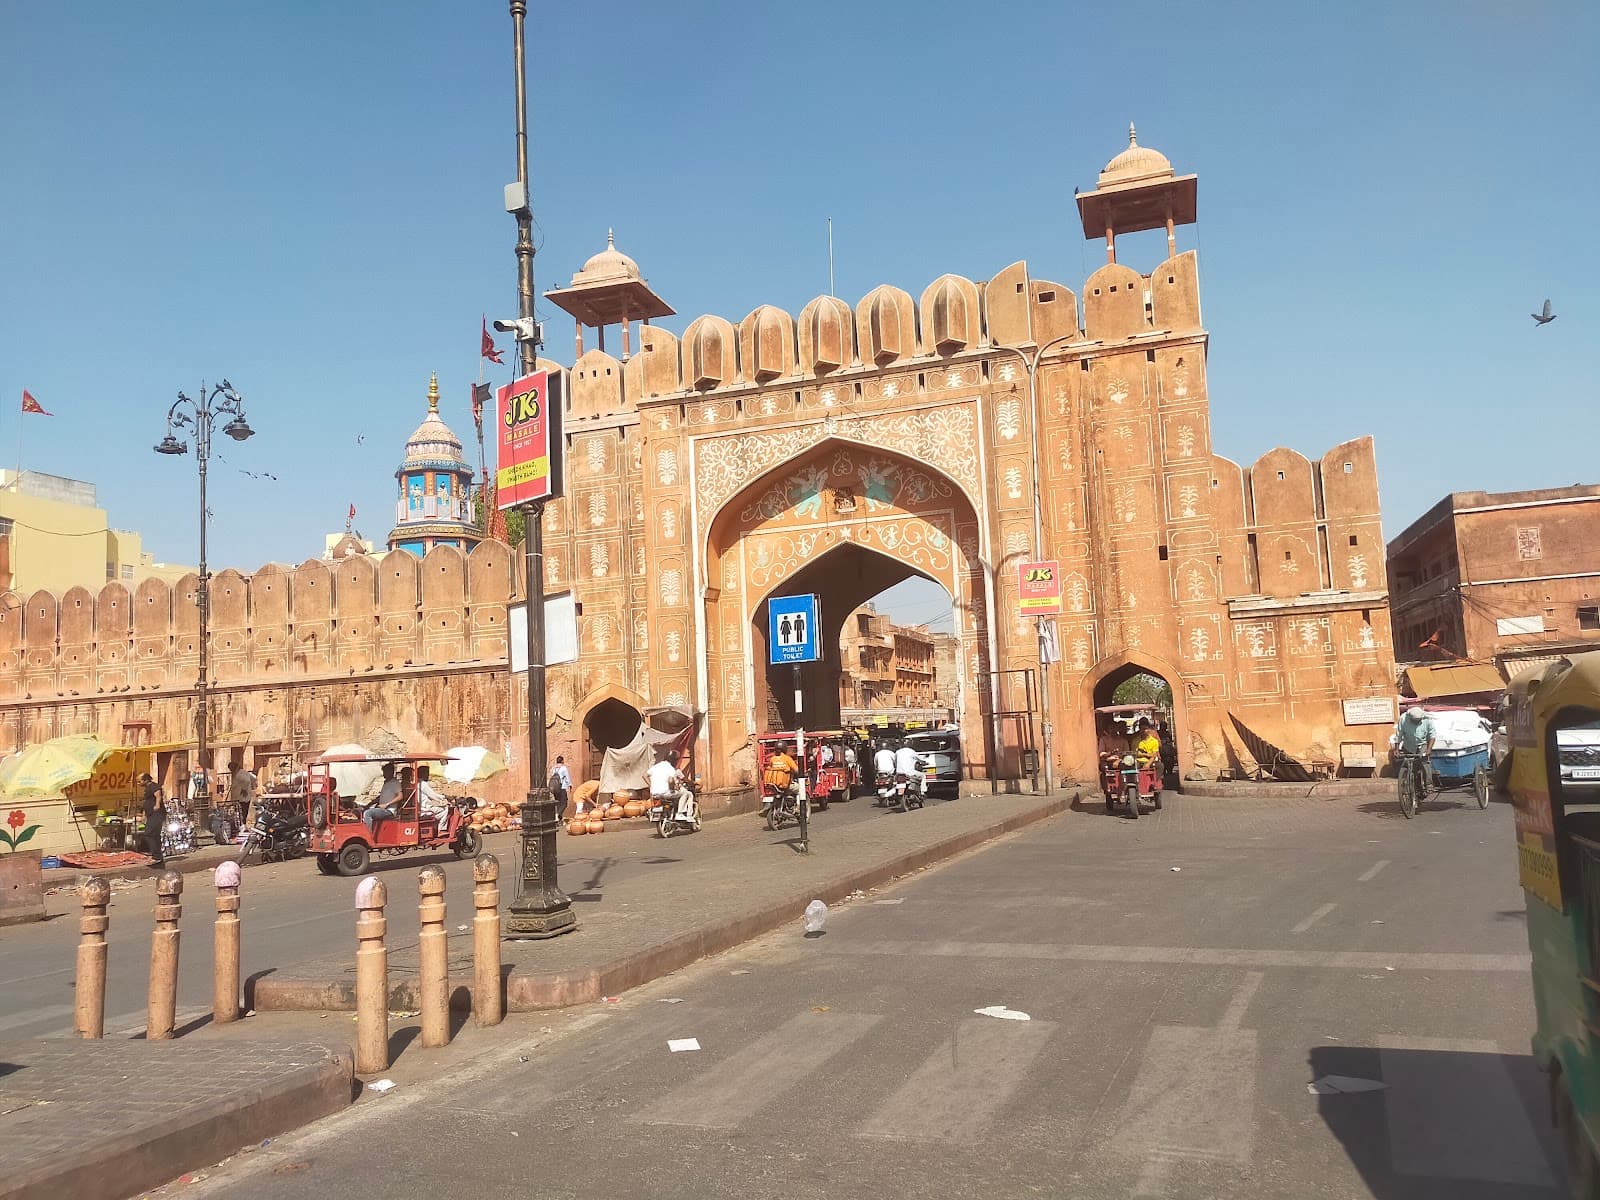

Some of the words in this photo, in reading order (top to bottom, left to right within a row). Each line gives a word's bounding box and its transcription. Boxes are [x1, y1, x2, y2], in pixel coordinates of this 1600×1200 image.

[505, 388, 540, 427] JK
[506, 424, 539, 443] MASALE
[1024, 568, 1054, 582] JK
[783, 652, 803, 660] TOILET
